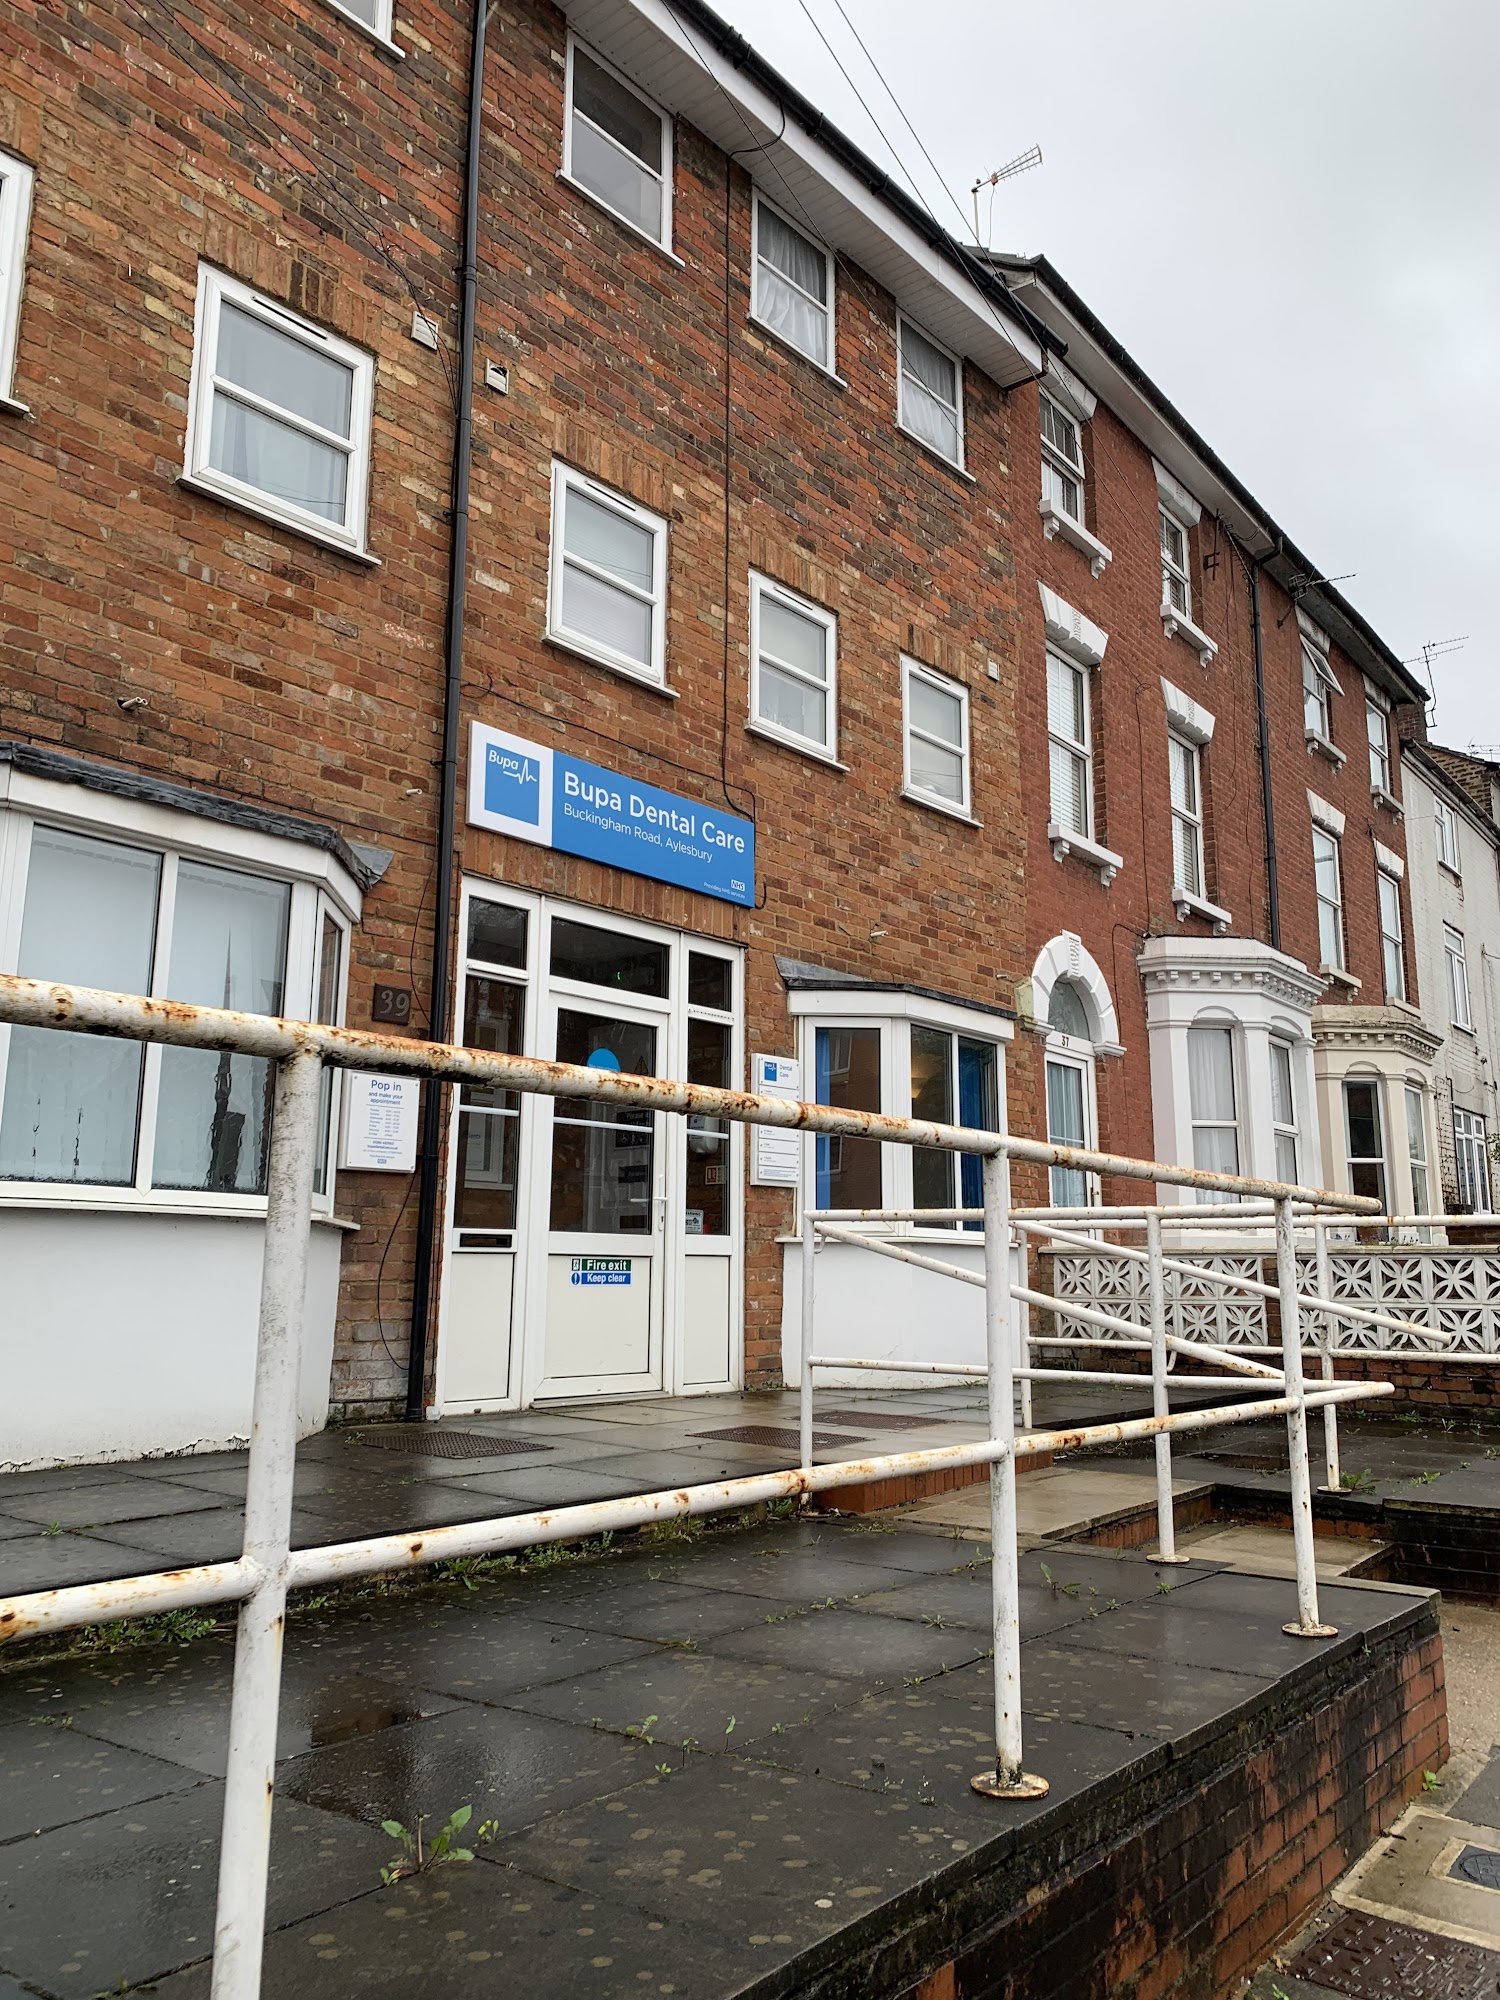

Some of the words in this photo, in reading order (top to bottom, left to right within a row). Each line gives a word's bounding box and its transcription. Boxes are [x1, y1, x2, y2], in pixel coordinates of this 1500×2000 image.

[489, 749, 519, 770] Bupa
[564, 771, 622, 812] Bupa
[630, 794, 695, 837] Dental
[702, 821, 745, 853] Care
[564, 802, 632, 835] Buckingham
[634, 826, 663, 847] Road,
[665, 837, 713, 864] Aylesbury
[732, 880, 745, 890] NHS
[379, 989, 410, 1017] 39
[1061, 1035, 1070, 1047] 37
[779, 1064, 793, 1072] Dental
[371, 1079, 390, 1092] Pop
[393, 1081, 402, 1091] in
[587, 1259, 607, 1270] Fire
[608, 1259, 627, 1270] exit
[587, 1273, 607, 1284] Keep
[607, 1273, 627, 1282] clear
